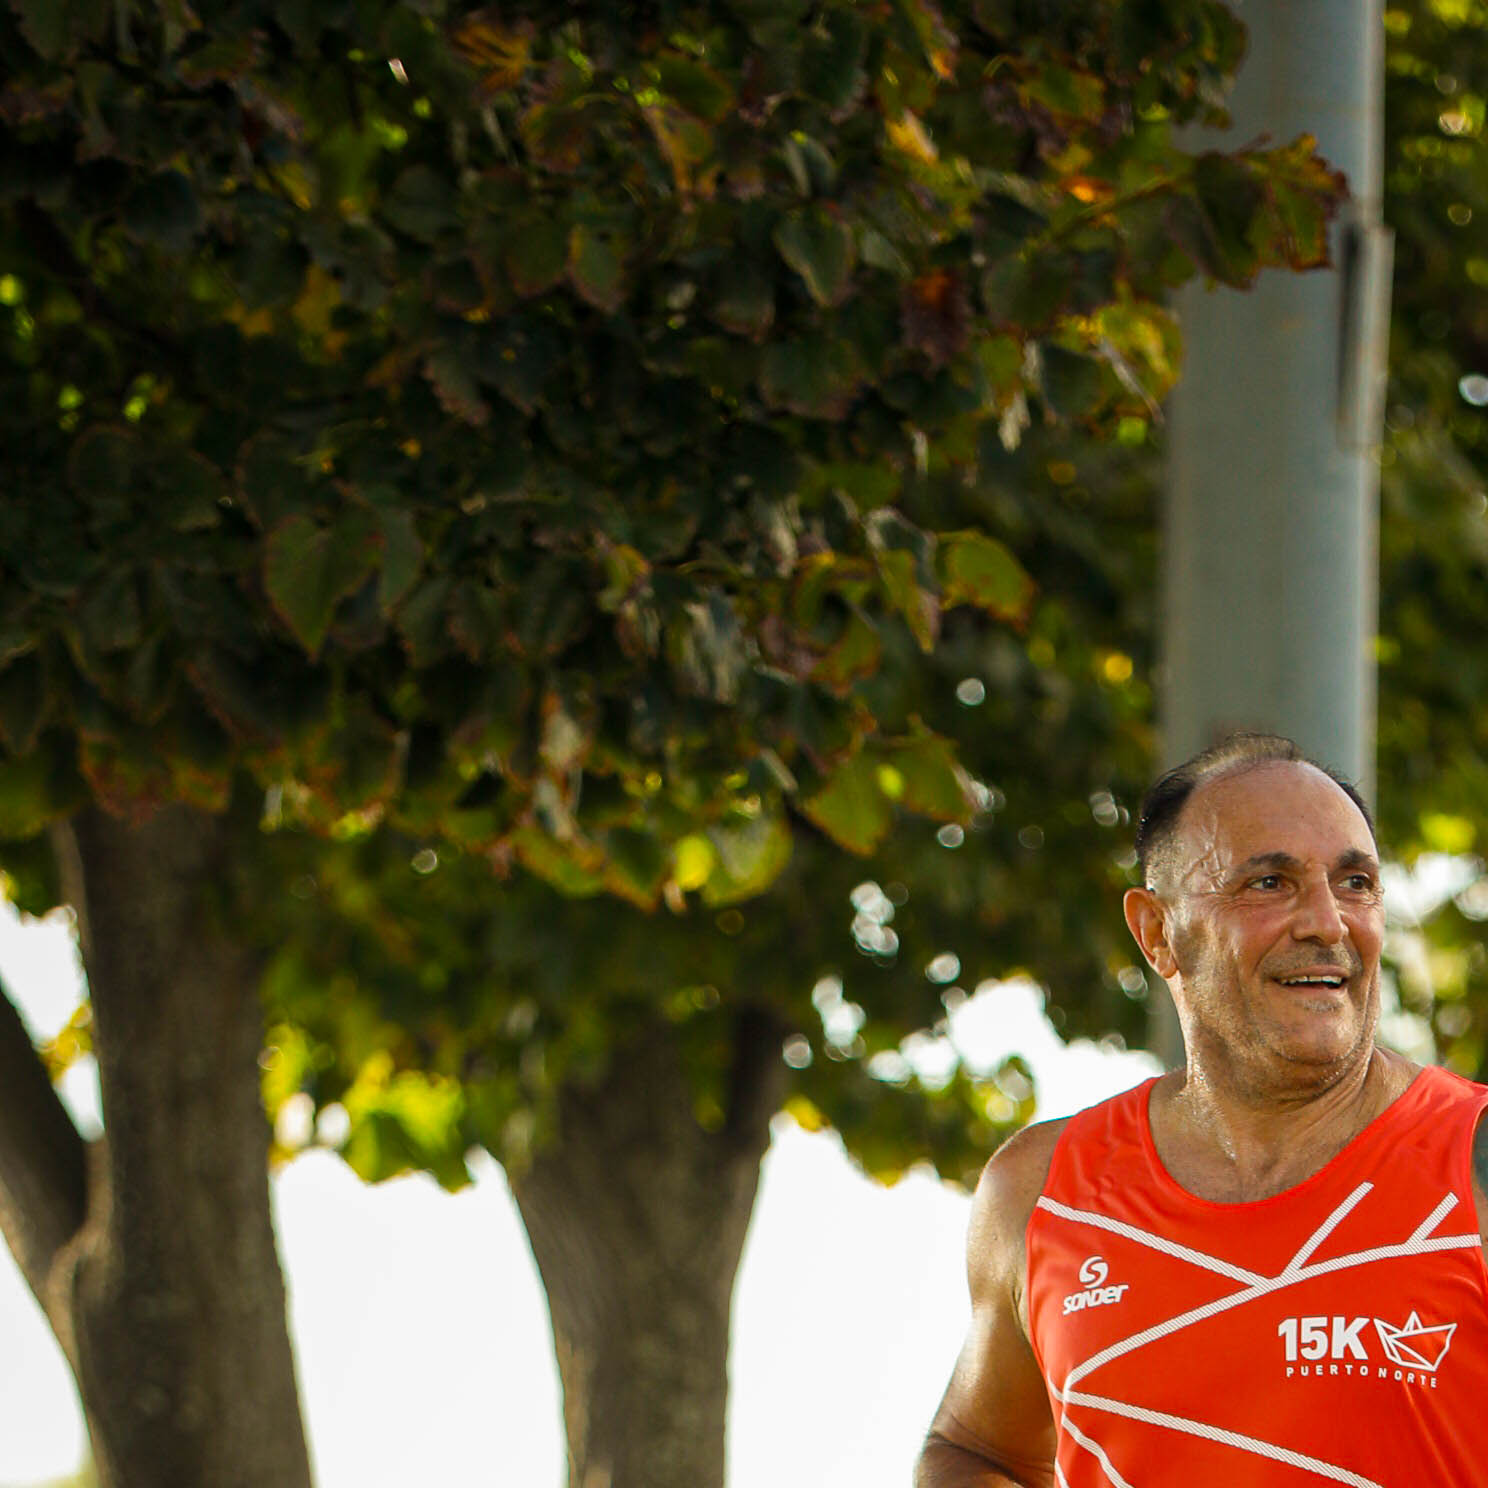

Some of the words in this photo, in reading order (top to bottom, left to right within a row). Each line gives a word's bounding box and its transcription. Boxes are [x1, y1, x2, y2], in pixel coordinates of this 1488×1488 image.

[1277, 1316, 1371, 1362] 15K
[1286, 1364, 1370, 1378] PUERTO
[1377, 1367, 1438, 1389] NORTE
